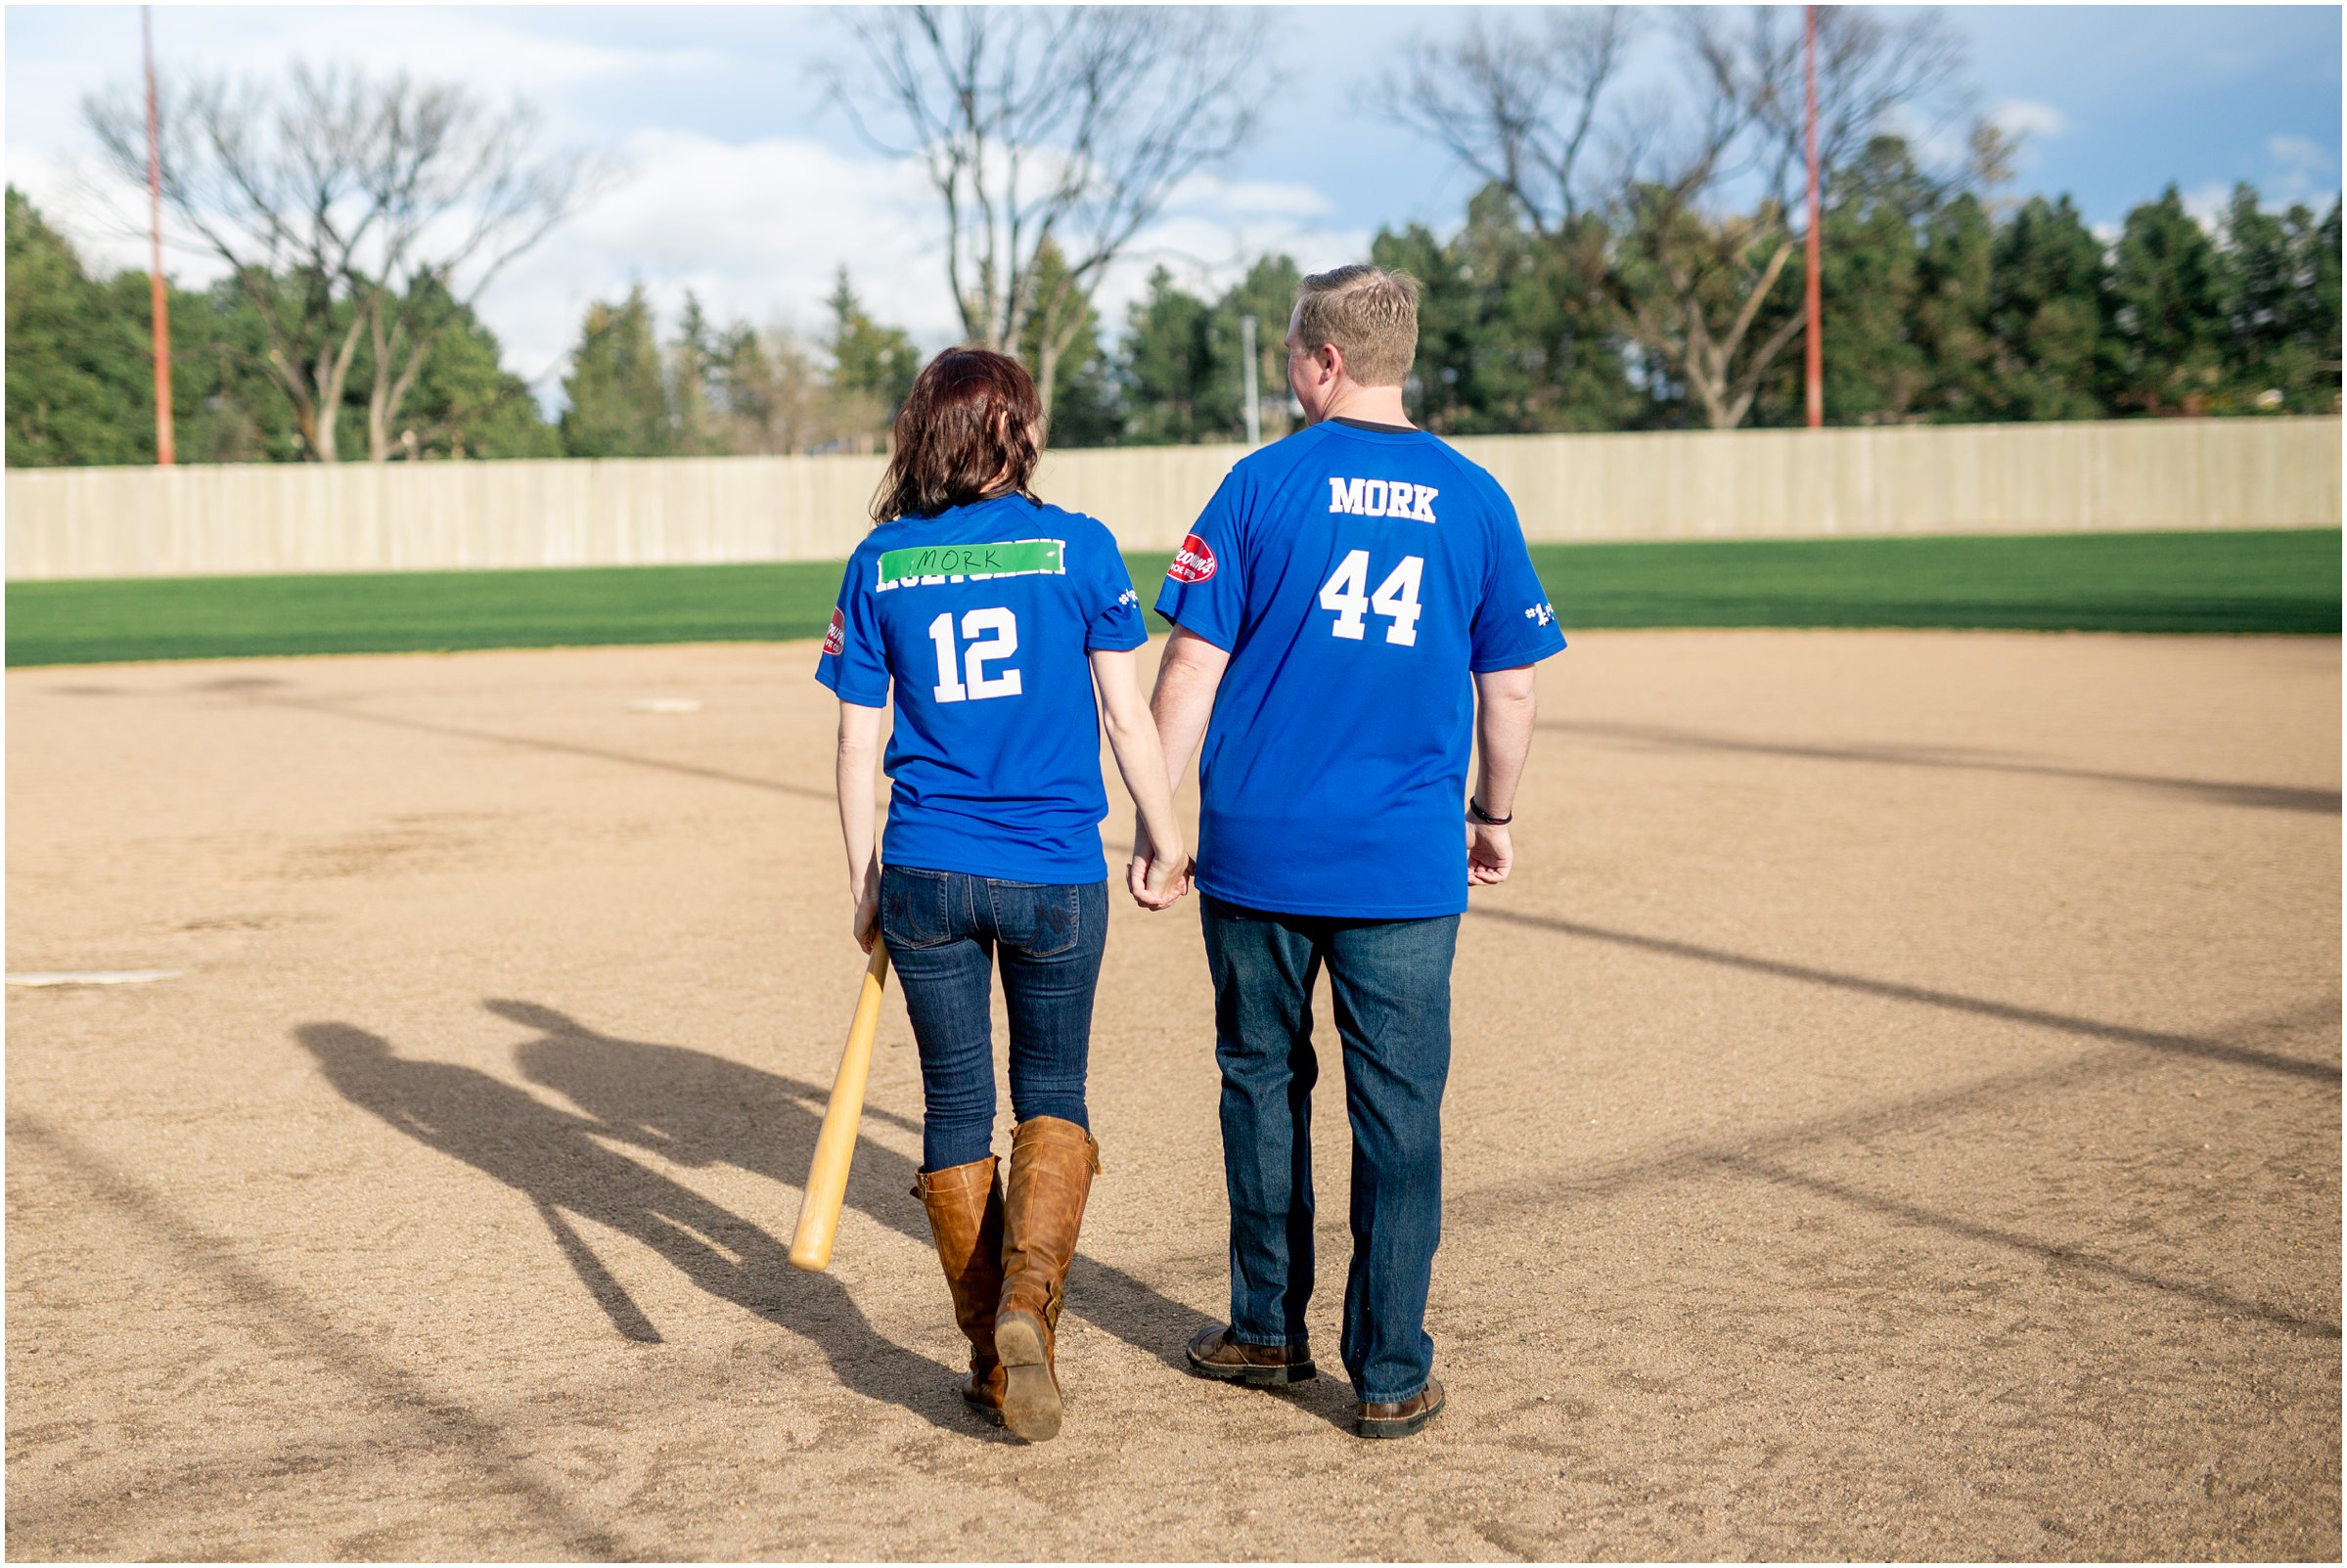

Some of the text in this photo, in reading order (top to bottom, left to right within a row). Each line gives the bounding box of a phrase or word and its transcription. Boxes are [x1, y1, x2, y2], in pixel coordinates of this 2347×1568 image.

[1329, 476, 1439, 524] MORK
[916, 549, 1003, 571] MORK
[1319, 549, 1424, 648] 44
[928, 606, 1022, 703] 12
